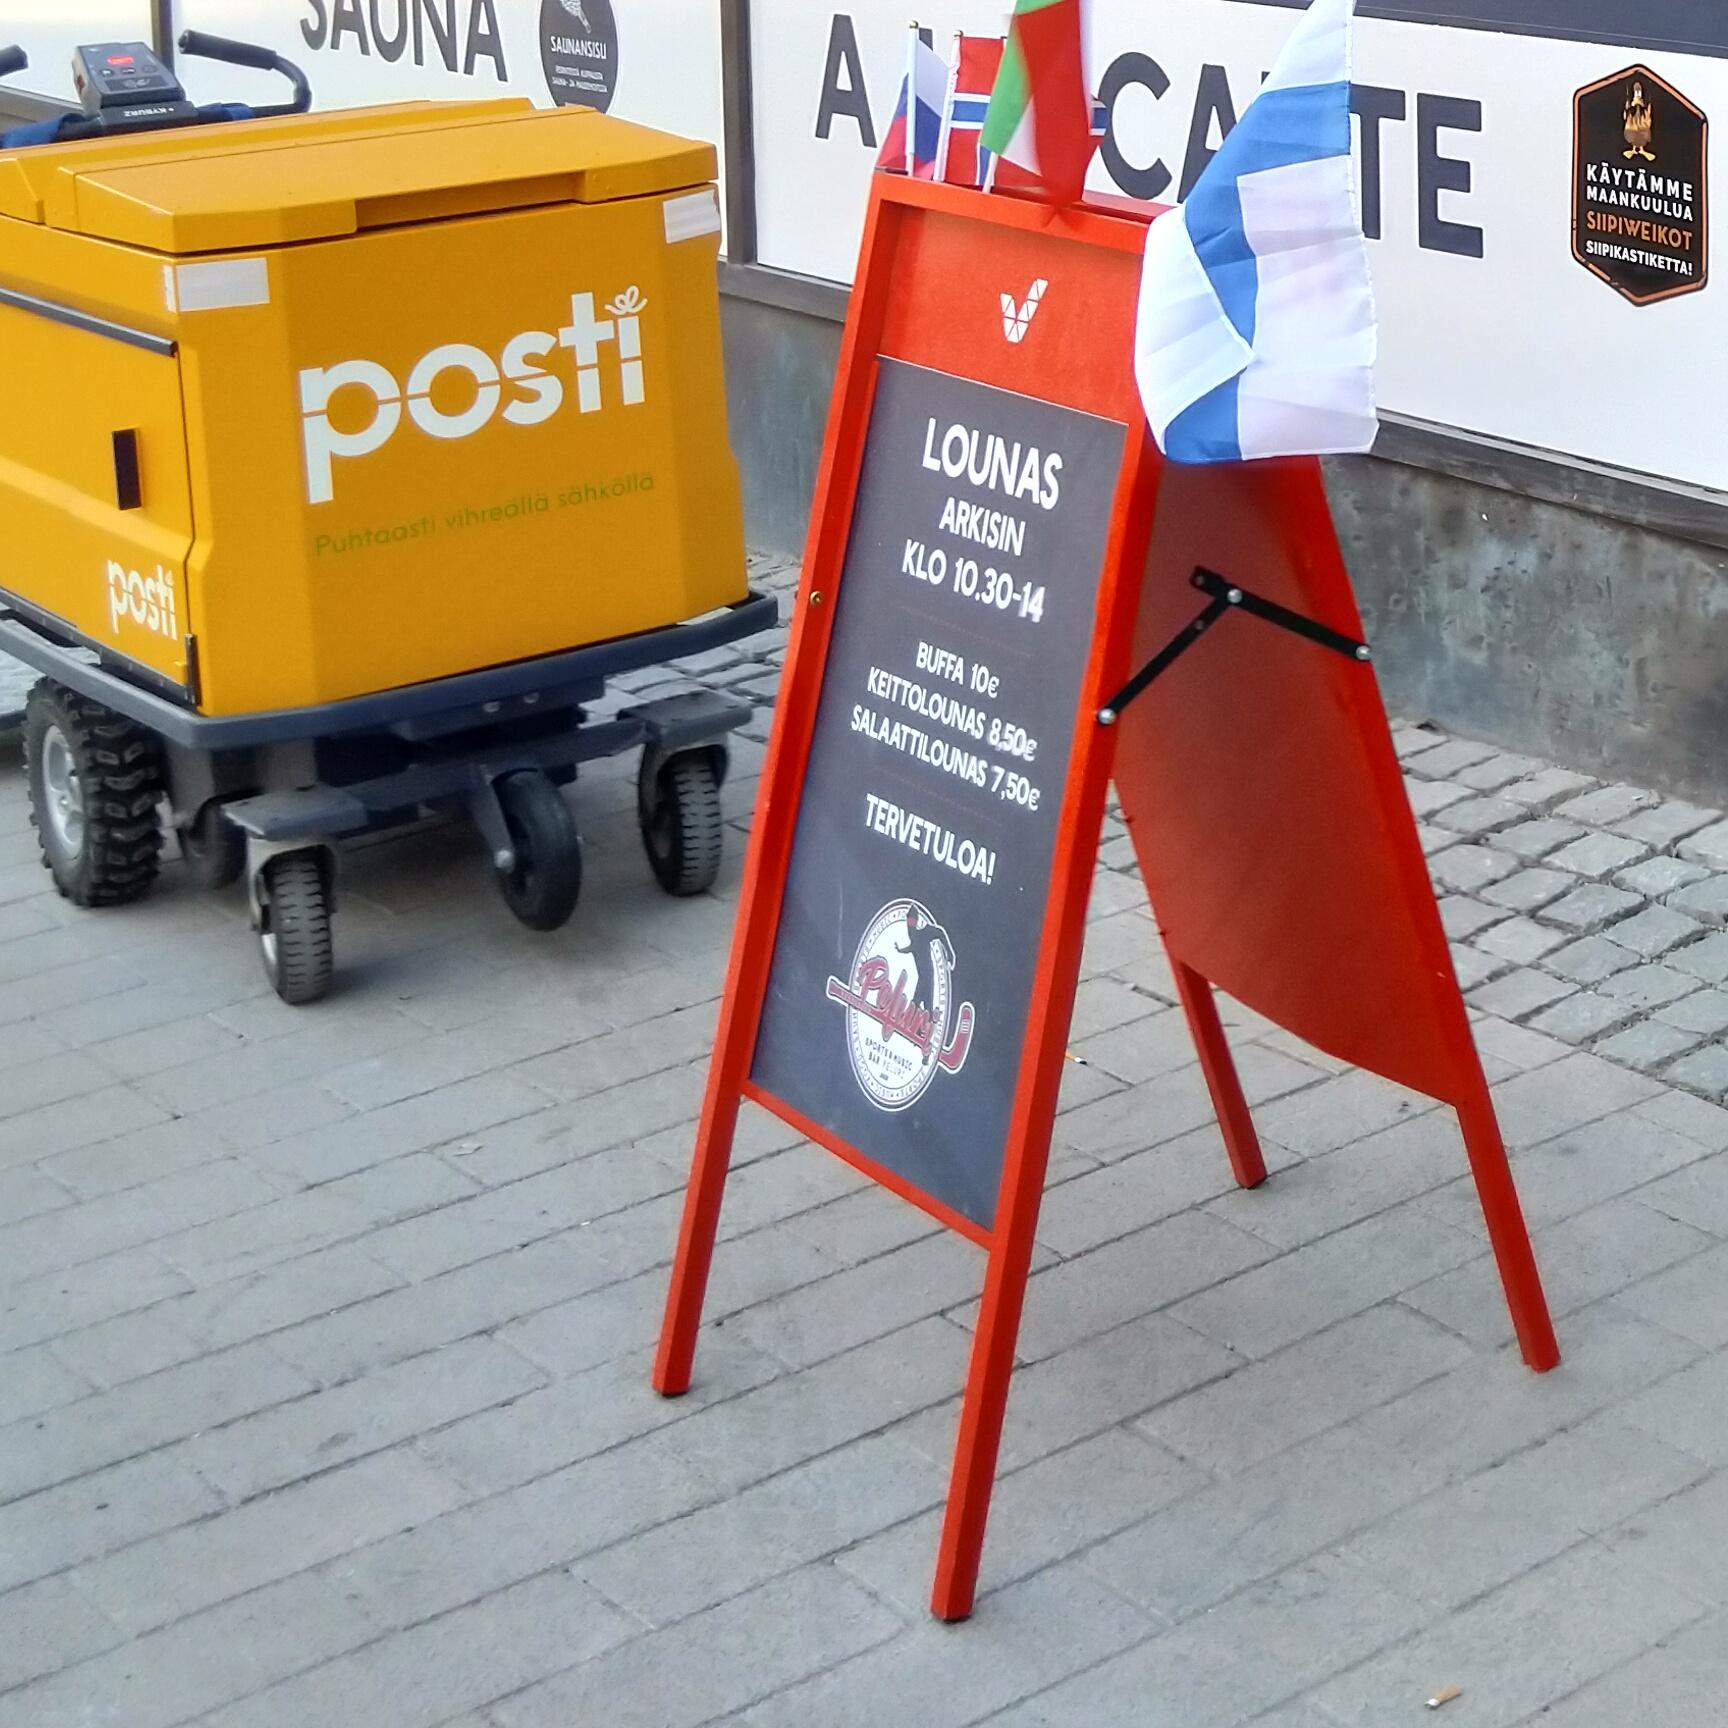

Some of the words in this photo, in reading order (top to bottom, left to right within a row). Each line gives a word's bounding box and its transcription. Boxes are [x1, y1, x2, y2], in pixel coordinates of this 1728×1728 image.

[550, 35, 607, 60] SAUNANSISU
[816, 13, 876, 148] A
[1100, 50, 1484, 258] CATE
[1586, 162, 1693, 202] KÄYTÄMME
[1586, 185, 1693, 222] MAANKUULUA
[1585, 240, 1693, 276] SIIPIKASTIKETTA!
[1586, 210, 1693, 250] SIIPIWEIKOT
[300, 284, 646, 504] posti
[923, 417, 1063, 511] LOUNAS
[313, 513, 438, 558] Puhtaasti
[444, 489, 550, 538] vihreällä
[556, 470, 656, 510] sähköllä
[939, 497, 1025, 557] ARKISIN
[107, 558, 178, 641] posti
[902, 539, 947, 587] KLO
[953, 558, 1045, 623] 10.30-14
[916, 640, 964, 684] BUFFA
[970, 662, 999, 699] 10€
[867, 666, 986, 742] KEITTOLOUNAS
[989, 718, 1038, 763] 8,50€
[851, 705, 987, 791] SALAATTILOUNAS
[991, 764, 1041, 812] 7,50€
[865, 792, 996, 885] TERVETULOA!
[868, 1051, 880, 1066] BAR
